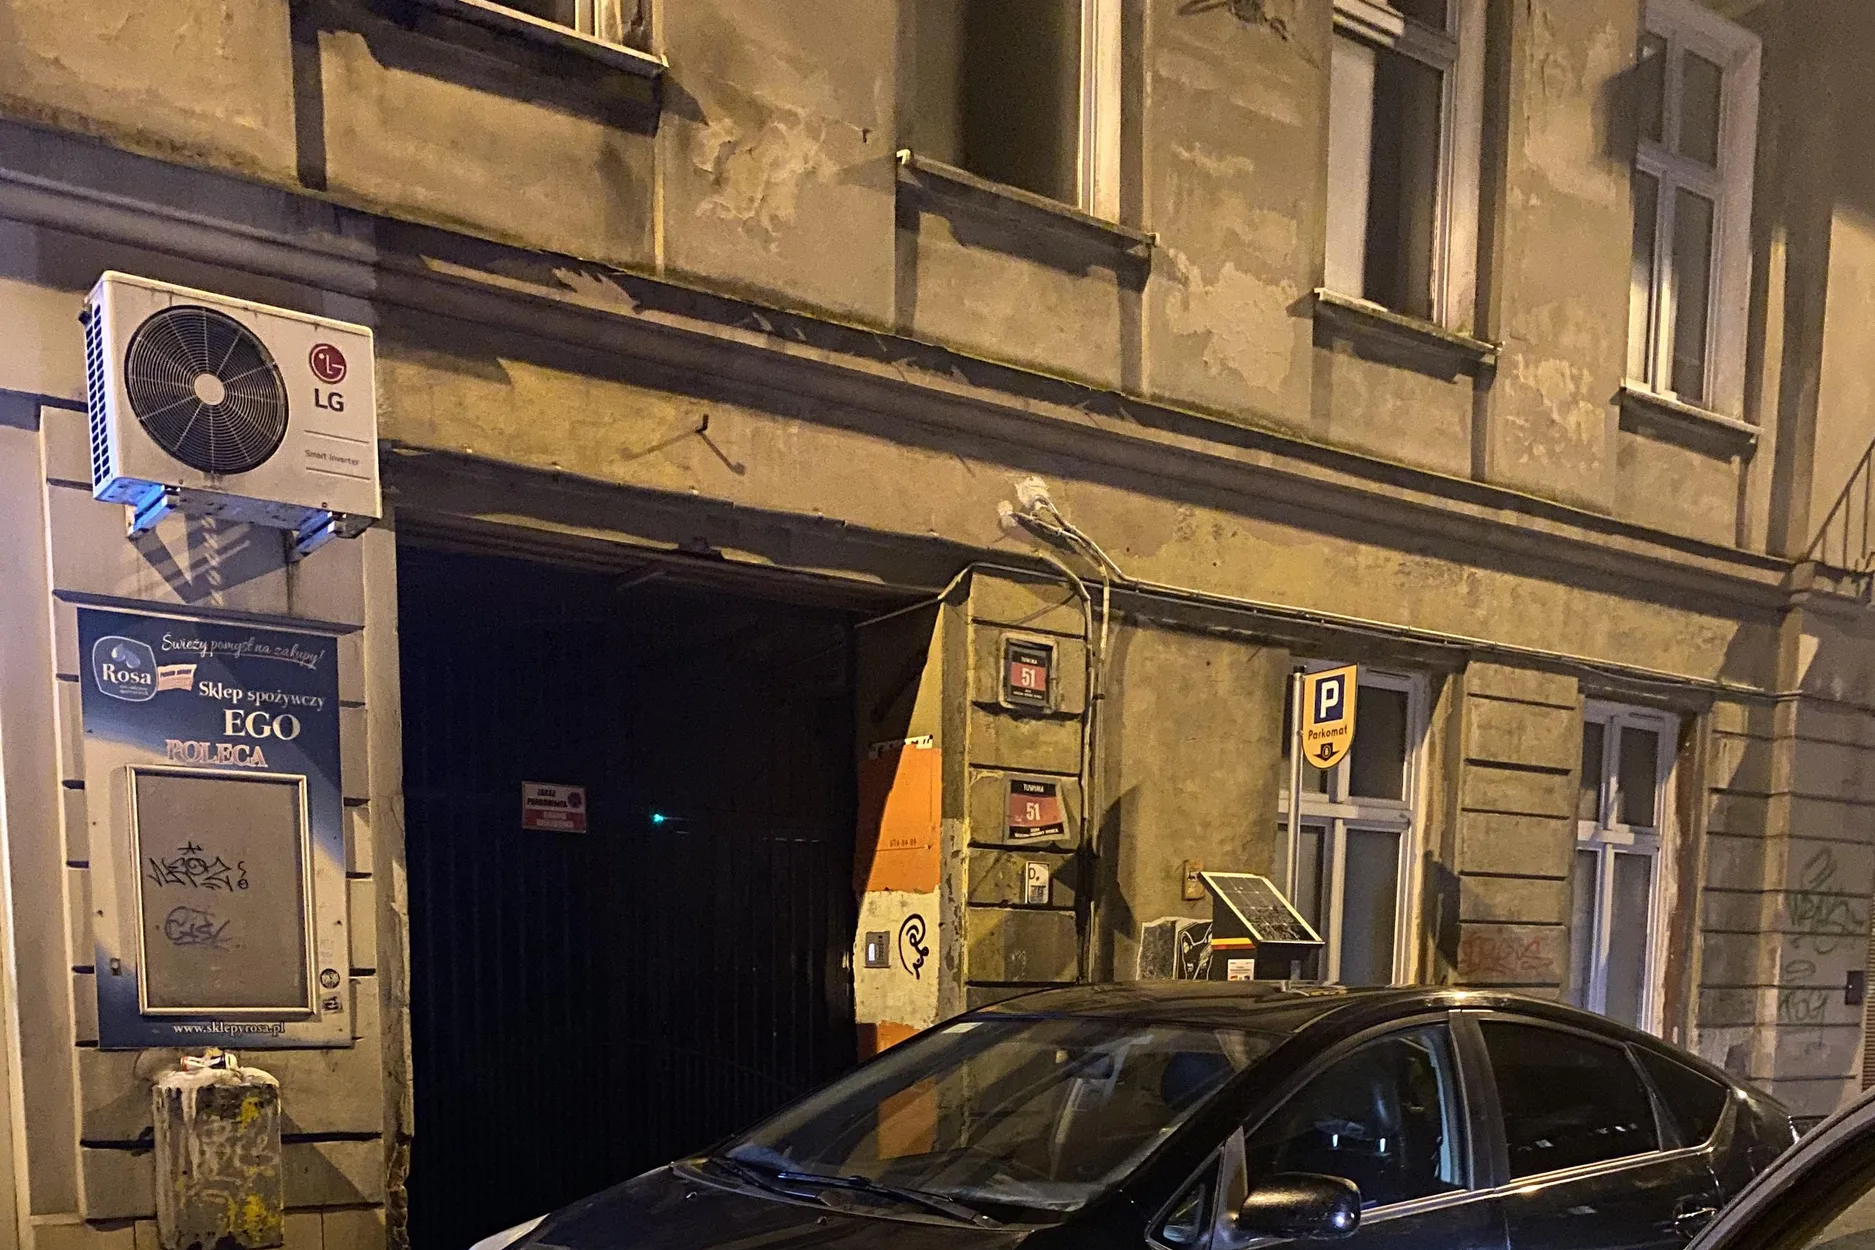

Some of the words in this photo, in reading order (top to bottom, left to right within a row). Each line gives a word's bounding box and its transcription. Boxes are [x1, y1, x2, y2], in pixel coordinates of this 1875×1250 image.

[314, 388, 345, 412] LG
[304, 449, 327, 461] Smart
[161, 632, 208, 658] Świeży
[210, 637, 256, 658] pomysł
[255, 644, 270, 653] na
[274, 643, 325, 669] zakupy!
[102, 663, 152, 685] Rosa
[1021, 667, 1036, 688] 51
[199, 681, 243, 704] Sklep
[247, 688, 325, 711] spożywczy
[1320, 680, 1339, 718] P
[223, 708, 300, 740] EGO
[1308, 725, 1348, 740] Parkomat
[166, 739, 268, 768] POLECA
[1023, 783, 1044, 793] TUWIMA
[1026, 802, 1040, 820] 51
[173, 1022, 285, 1037] www.sklepyrosa.pl
